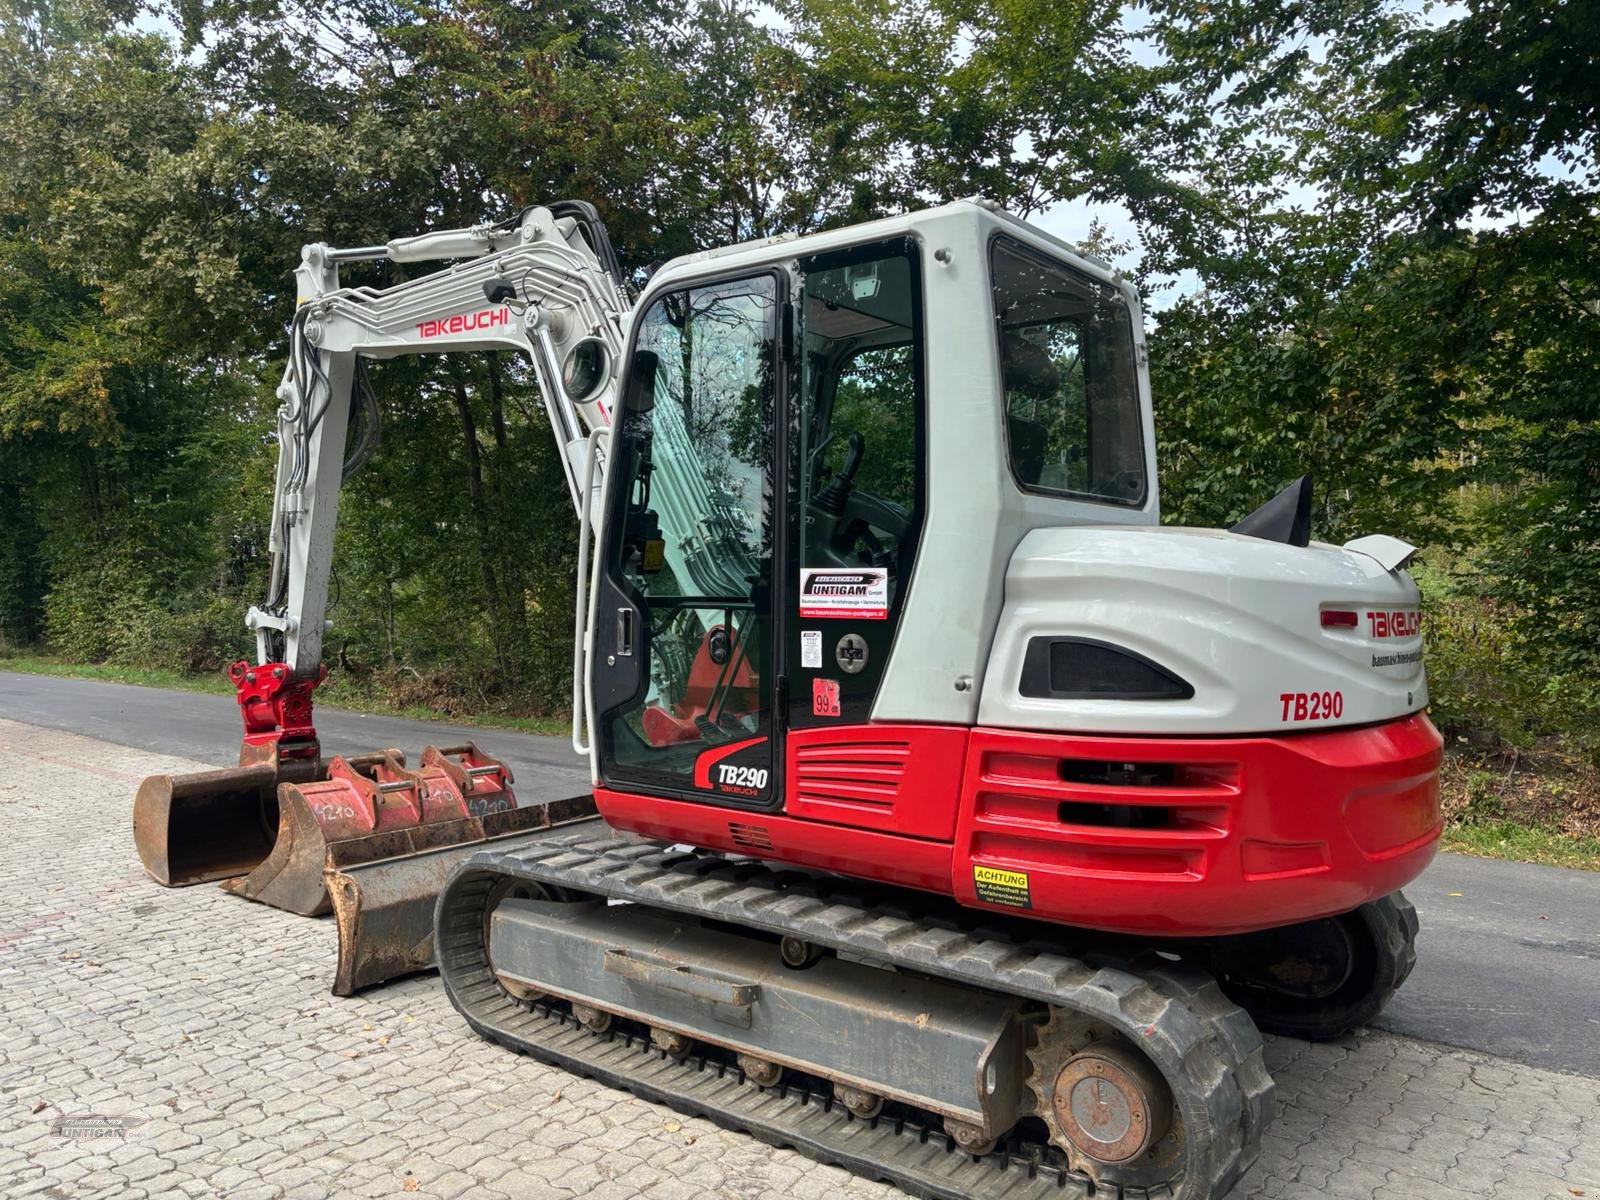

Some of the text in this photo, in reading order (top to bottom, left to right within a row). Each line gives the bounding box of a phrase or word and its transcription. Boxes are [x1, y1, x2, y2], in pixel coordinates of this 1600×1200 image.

[416, 308, 508, 338] TAKEUCHI
[804, 574, 870, 595] PUNTIGAM
[816, 694, 829, 713] 99
[1279, 691, 1343, 722] TB290
[718, 765, 768, 789] TB290
[720, 784, 758, 796] TAKEUCHI
[977, 870, 1025, 885] ACHTUNG
